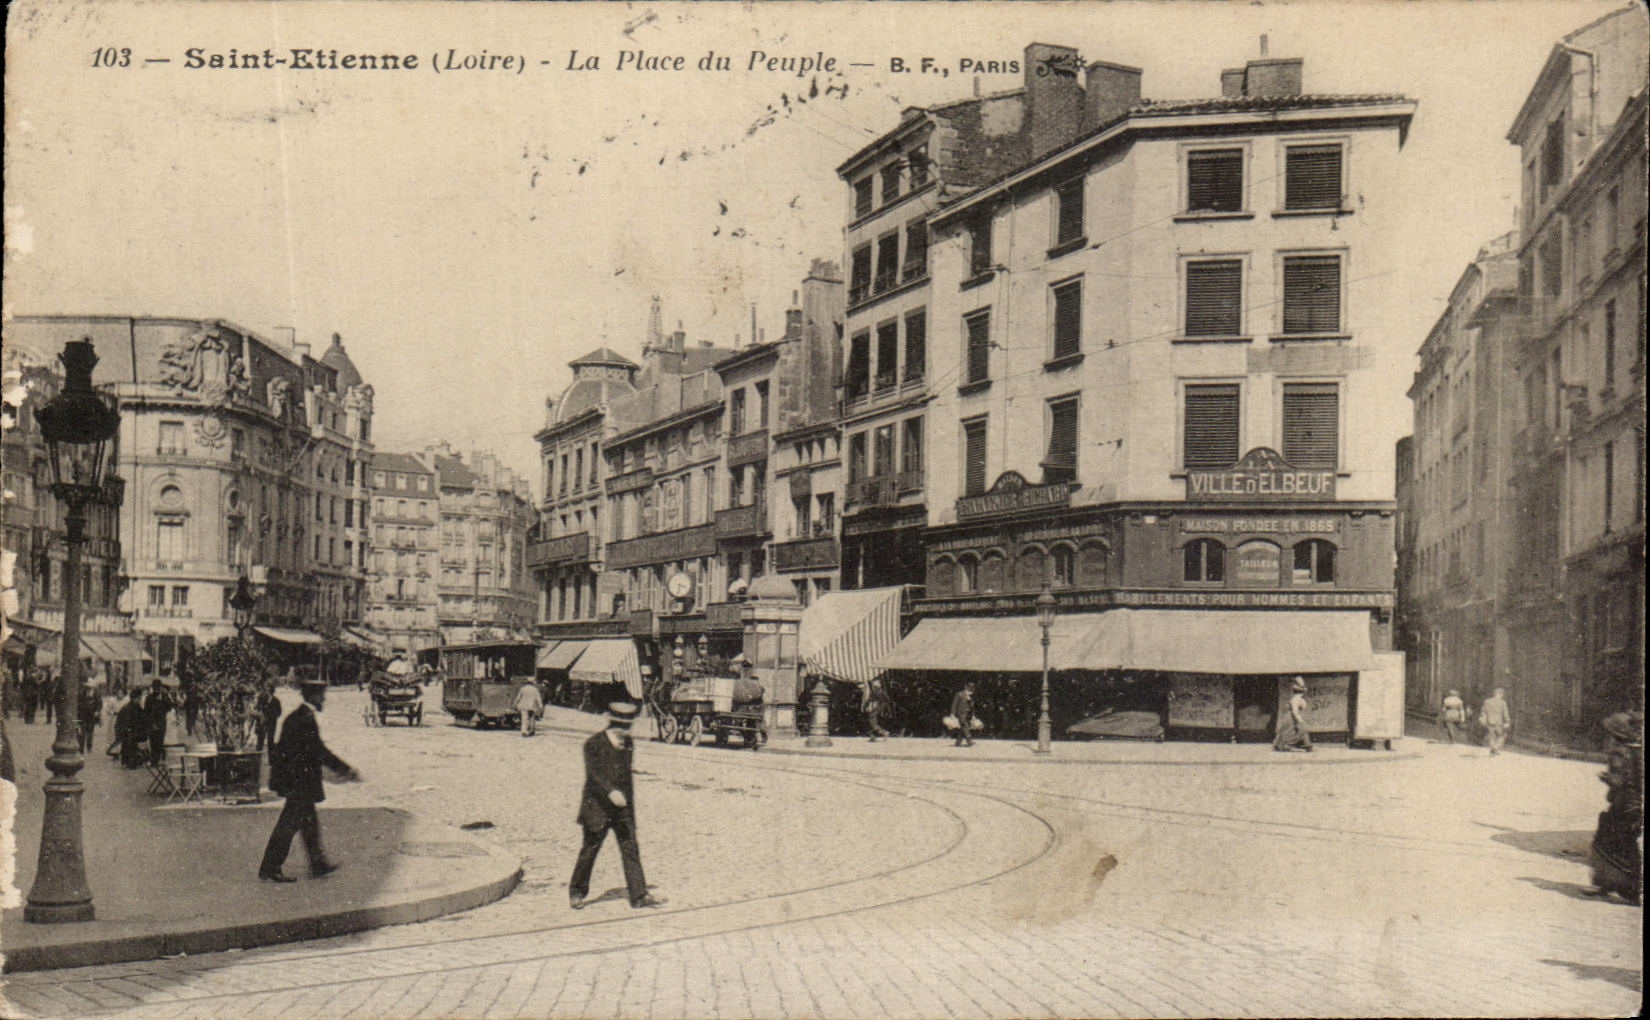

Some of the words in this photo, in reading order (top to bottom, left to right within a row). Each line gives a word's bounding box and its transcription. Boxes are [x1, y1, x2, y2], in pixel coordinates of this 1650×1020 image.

[1190, 473, 1245, 494] VILLE
[1186, 519, 1228, 532] MAISON
[1283, 519, 1299, 532] EN
[1303, 519, 1335, 532] 1865
[1115, 592, 1206, 605] HABILLEMENTS
[1212, 593, 1245, 605] POUR
[1252, 593, 1307, 606] HOMMES
[1312, 593, 1328, 606] ET
[1334, 593, 1391, 606] ENFANTS
